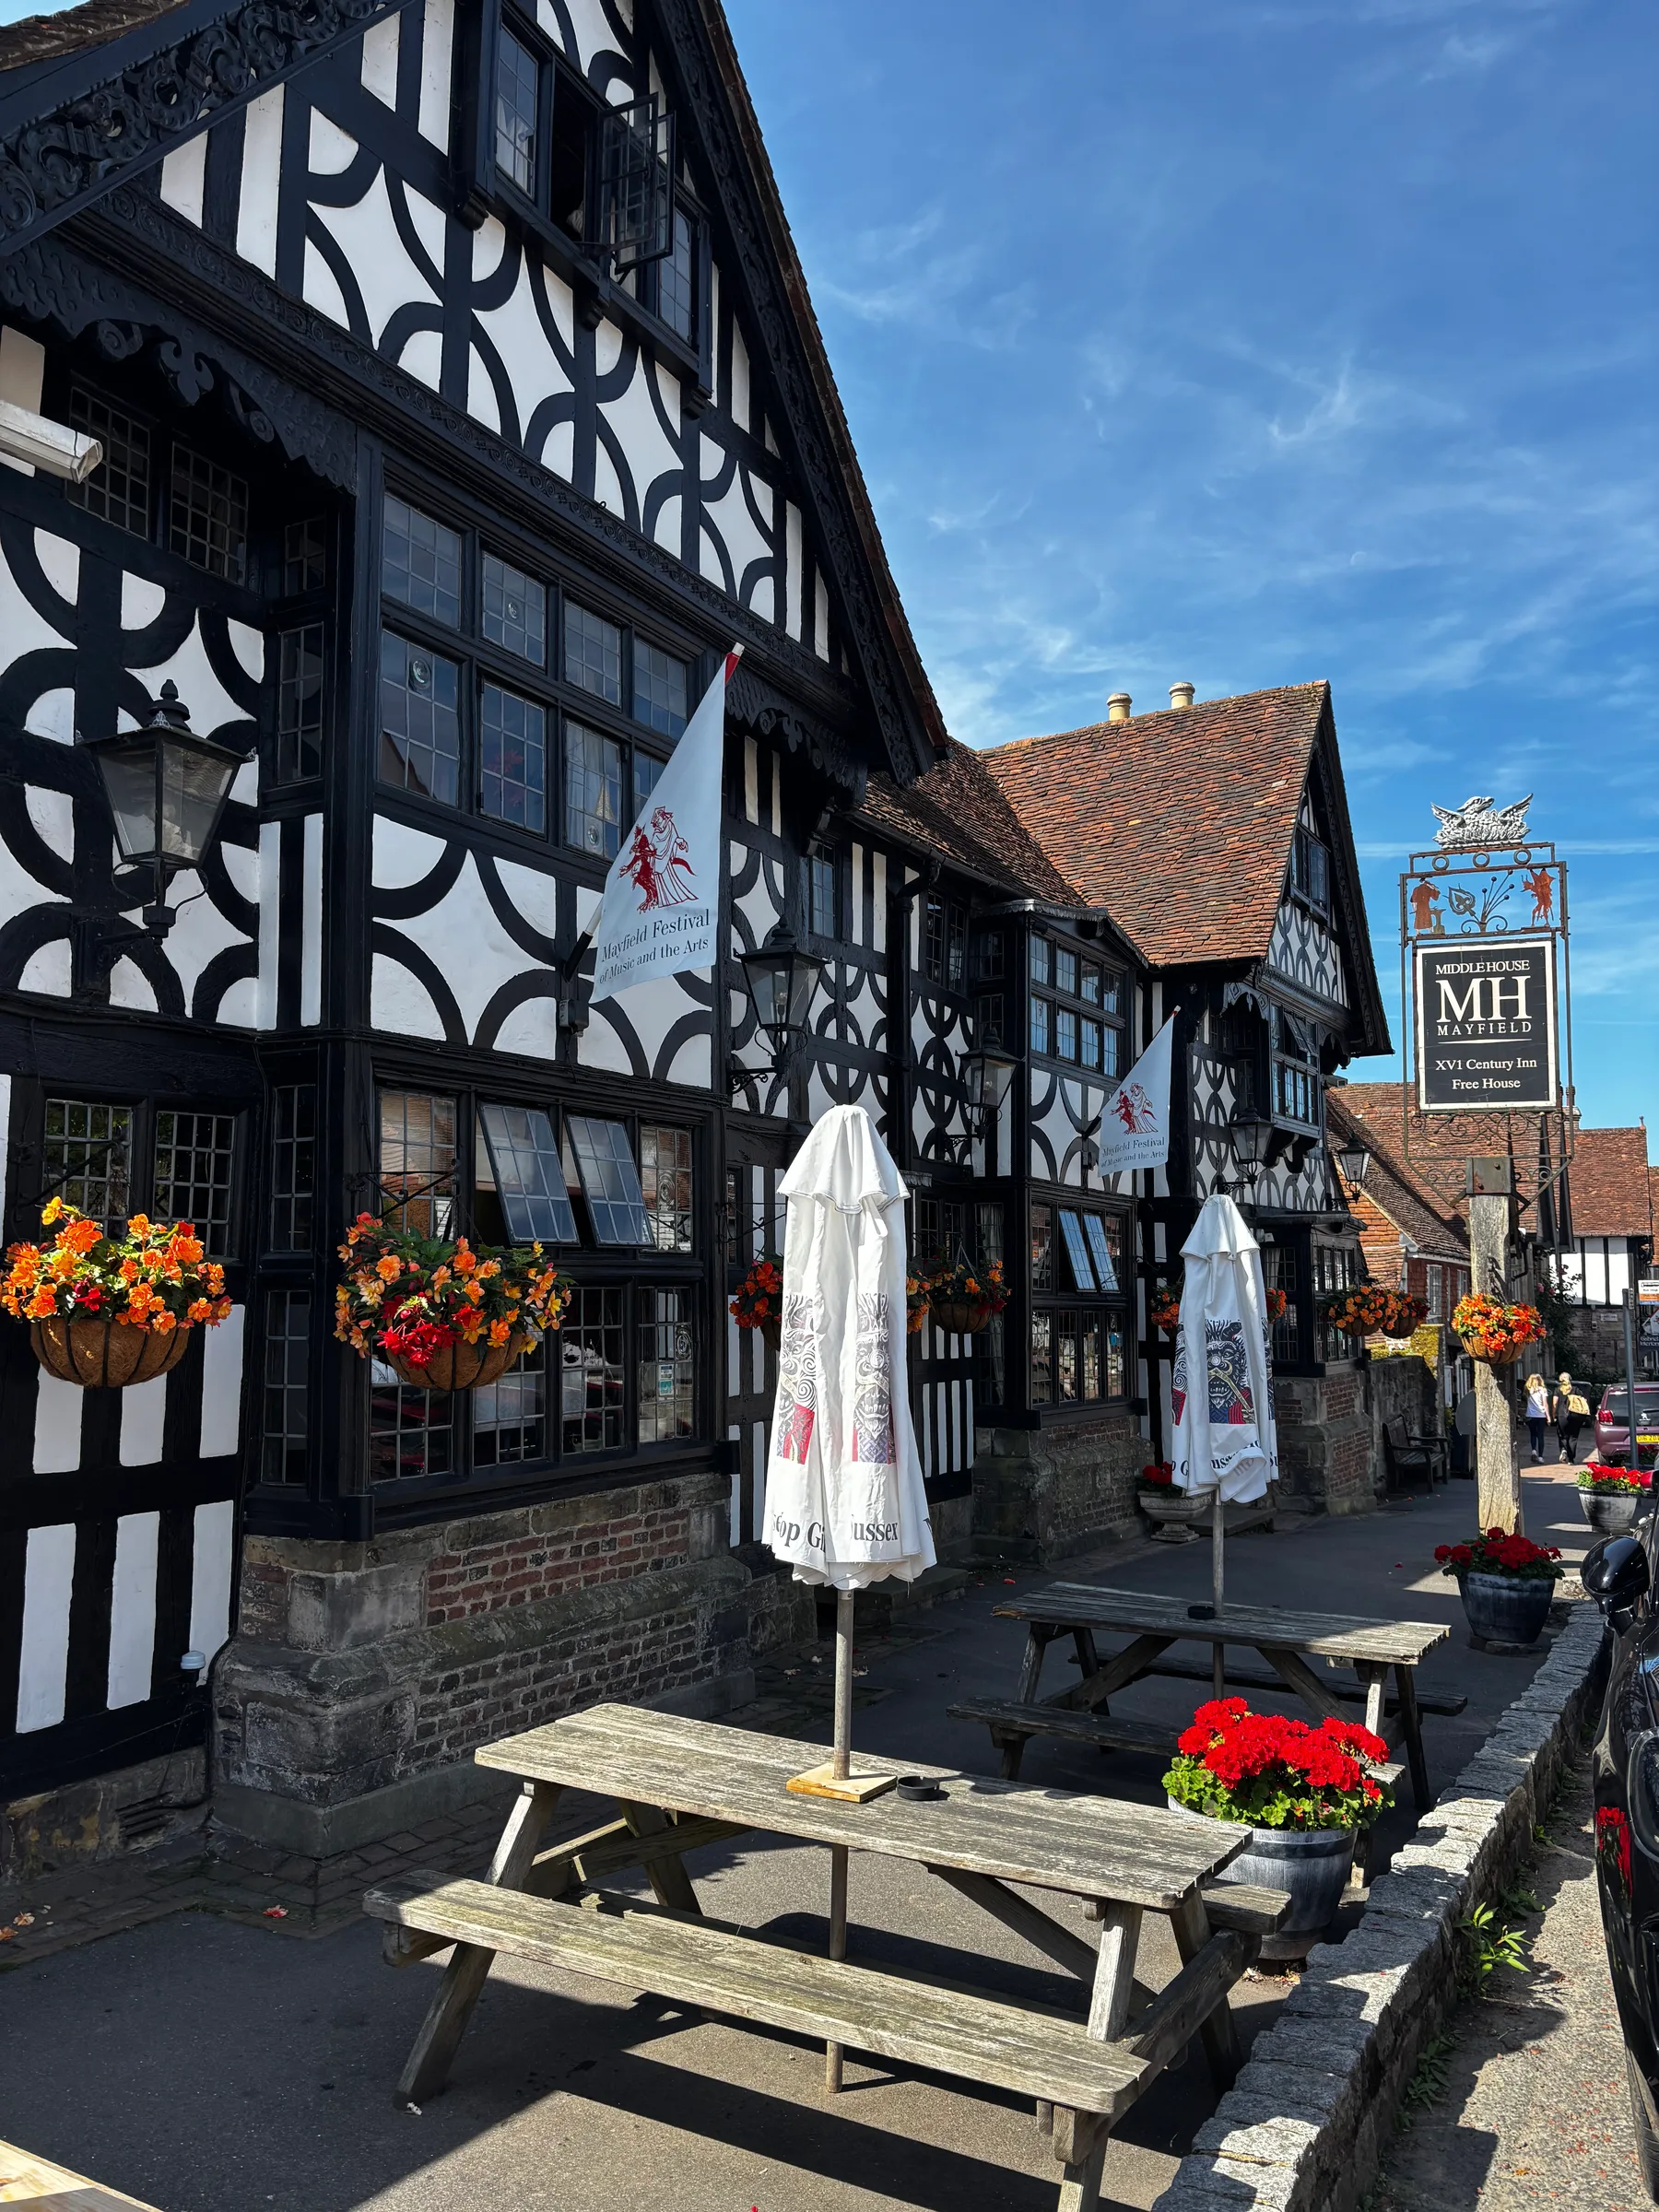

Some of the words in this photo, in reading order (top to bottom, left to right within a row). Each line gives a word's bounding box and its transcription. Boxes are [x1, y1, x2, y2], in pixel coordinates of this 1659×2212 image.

[602, 924, 648, 962] Mayfield
[652, 909, 710, 938] Festival
[599, 969, 609, 984] of
[609, 959, 635, 980] Music
[637, 947, 656, 966] and
[660, 943, 680, 959] the
[683, 938, 709, 955] Arts
[1435, 962, 1486, 975] MIDDLE
[1486, 959, 1531, 972] HOUSE
[1435, 975, 1533, 1023] MH
[1437, 1021, 1532, 1036] MAYFIELD
[1465, 1058, 1514, 1072] Century
[1516, 1057, 1537, 1068] Inn
[1452, 1078, 1480, 1090] Free
[1482, 1077, 1522, 1089] House
[1133, 1136, 1165, 1149] Festival
[1124, 1153, 1136, 1161] and
[1138, 1151, 1149, 1159] the
[1150, 1150, 1165, 1159] Arts
[851, 1514, 899, 1542] ussex
